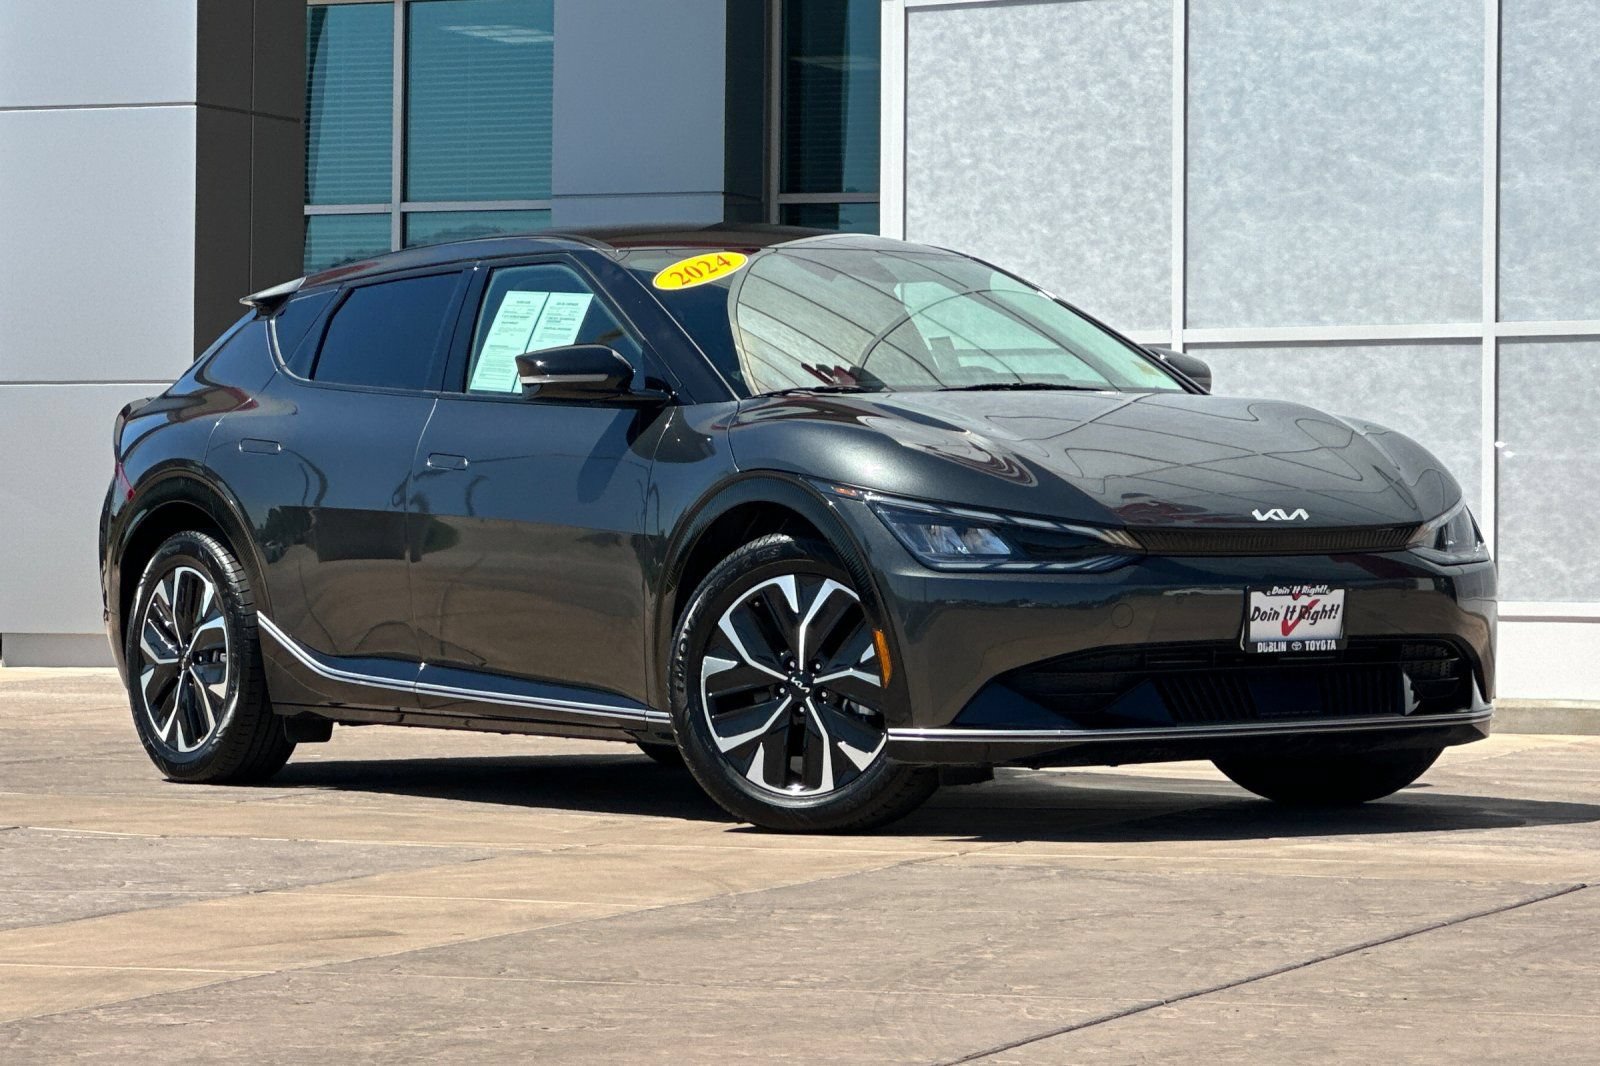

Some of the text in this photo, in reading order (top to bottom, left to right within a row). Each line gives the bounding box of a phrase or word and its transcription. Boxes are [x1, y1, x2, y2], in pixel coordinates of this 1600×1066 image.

[670, 255, 731, 285] 2024
[1252, 508, 1310, 521] KIA
[1292, 585, 1301, 595] It
[1301, 585, 1327, 597] Right!
[1284, 605, 1297, 620] It
[1299, 604, 1340, 625] Right!
[1257, 640, 1336, 653] DUBLIN TOYOTA
